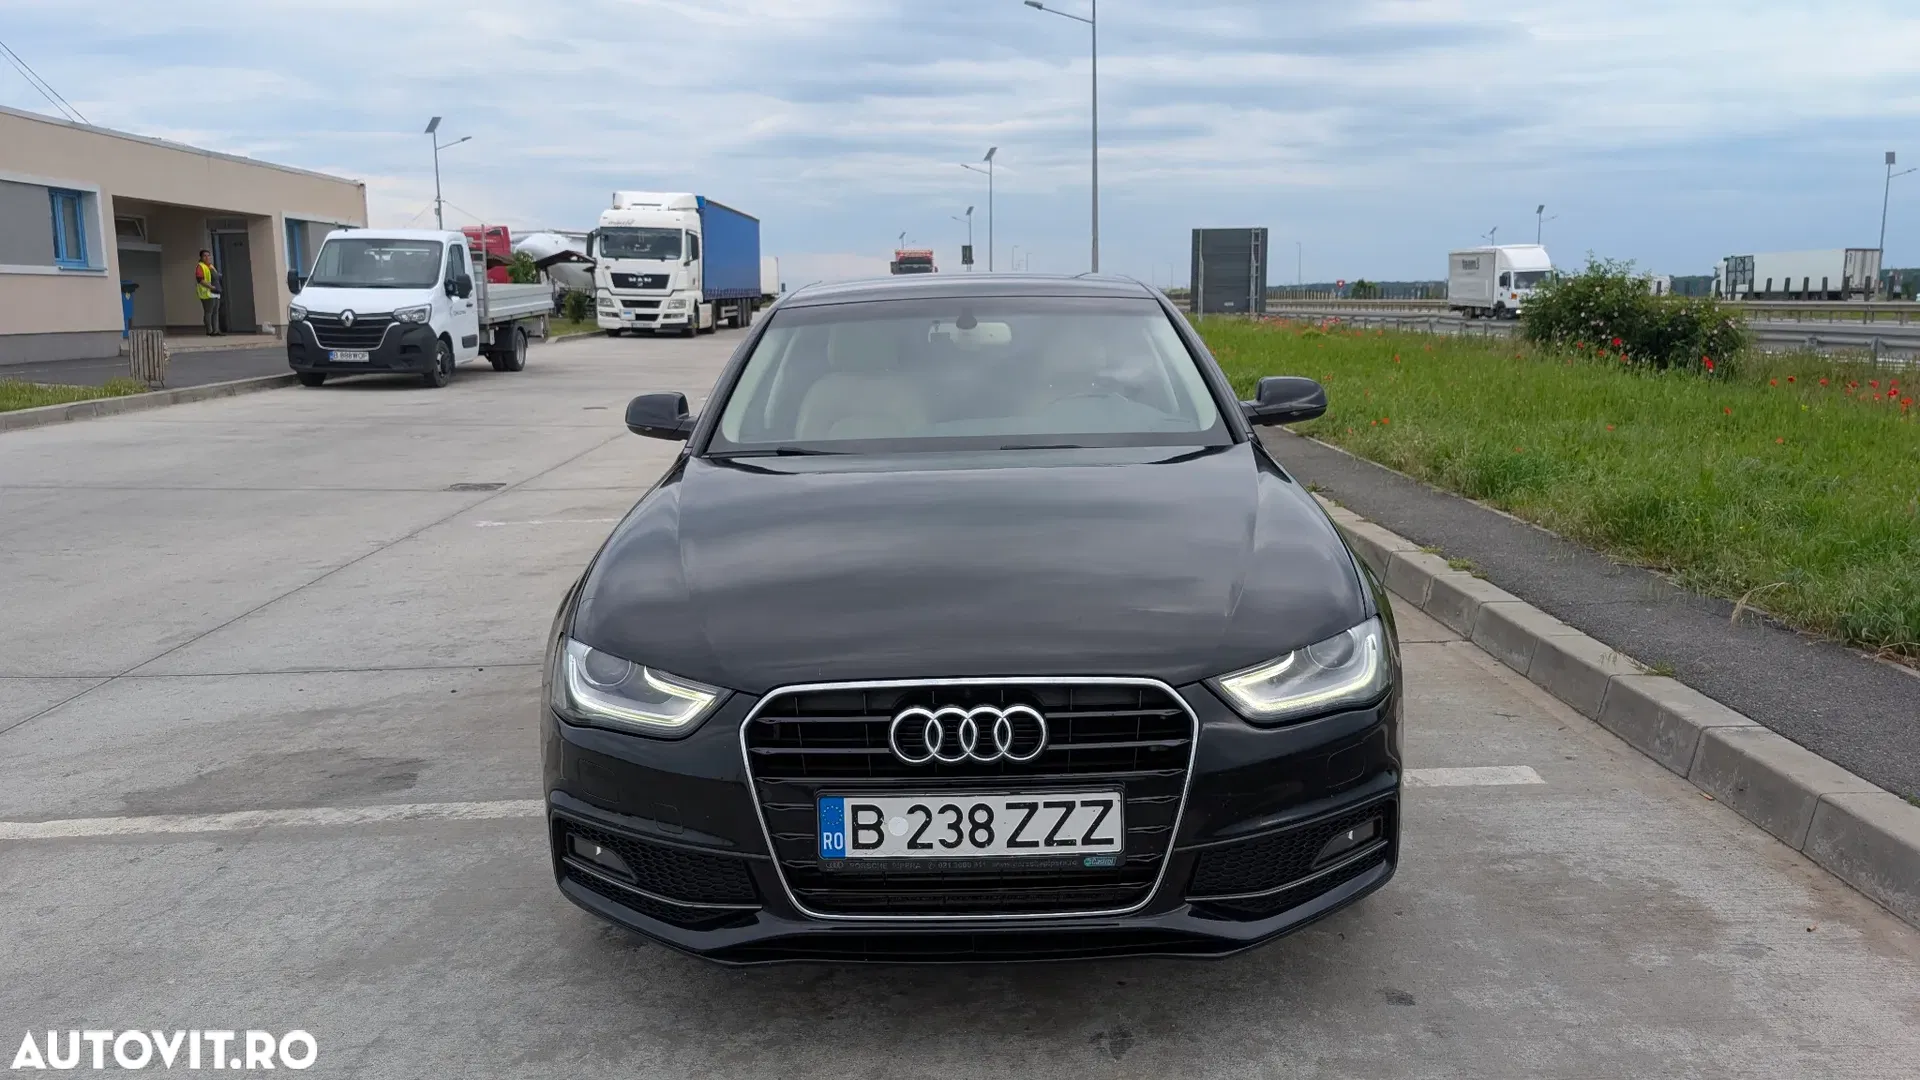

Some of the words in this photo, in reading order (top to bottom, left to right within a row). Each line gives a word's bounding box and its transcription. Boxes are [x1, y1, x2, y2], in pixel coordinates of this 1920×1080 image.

[823, 831, 844, 851] RO
[850, 804, 885, 850] B
[906, 802, 996, 850] 238
[1005, 799, 1115, 849] ZZZ
